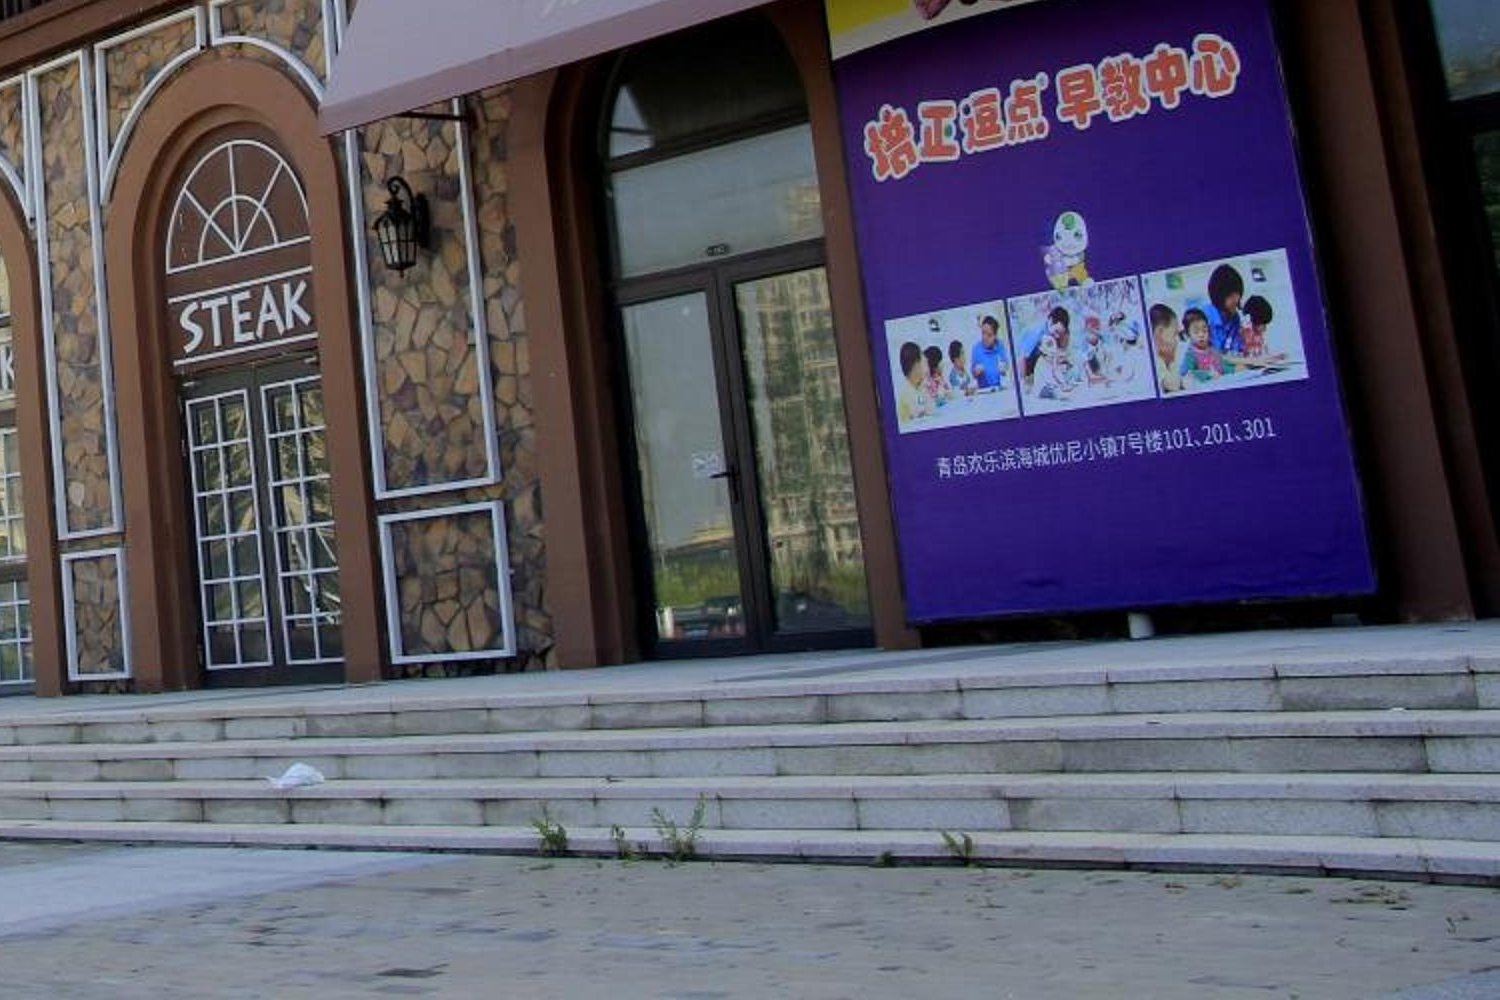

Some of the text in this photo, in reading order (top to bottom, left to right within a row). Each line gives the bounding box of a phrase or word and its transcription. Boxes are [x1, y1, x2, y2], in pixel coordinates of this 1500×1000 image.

[1056, 33, 1242, 130] 早教中心
[180, 279, 311, 353] STEAK
